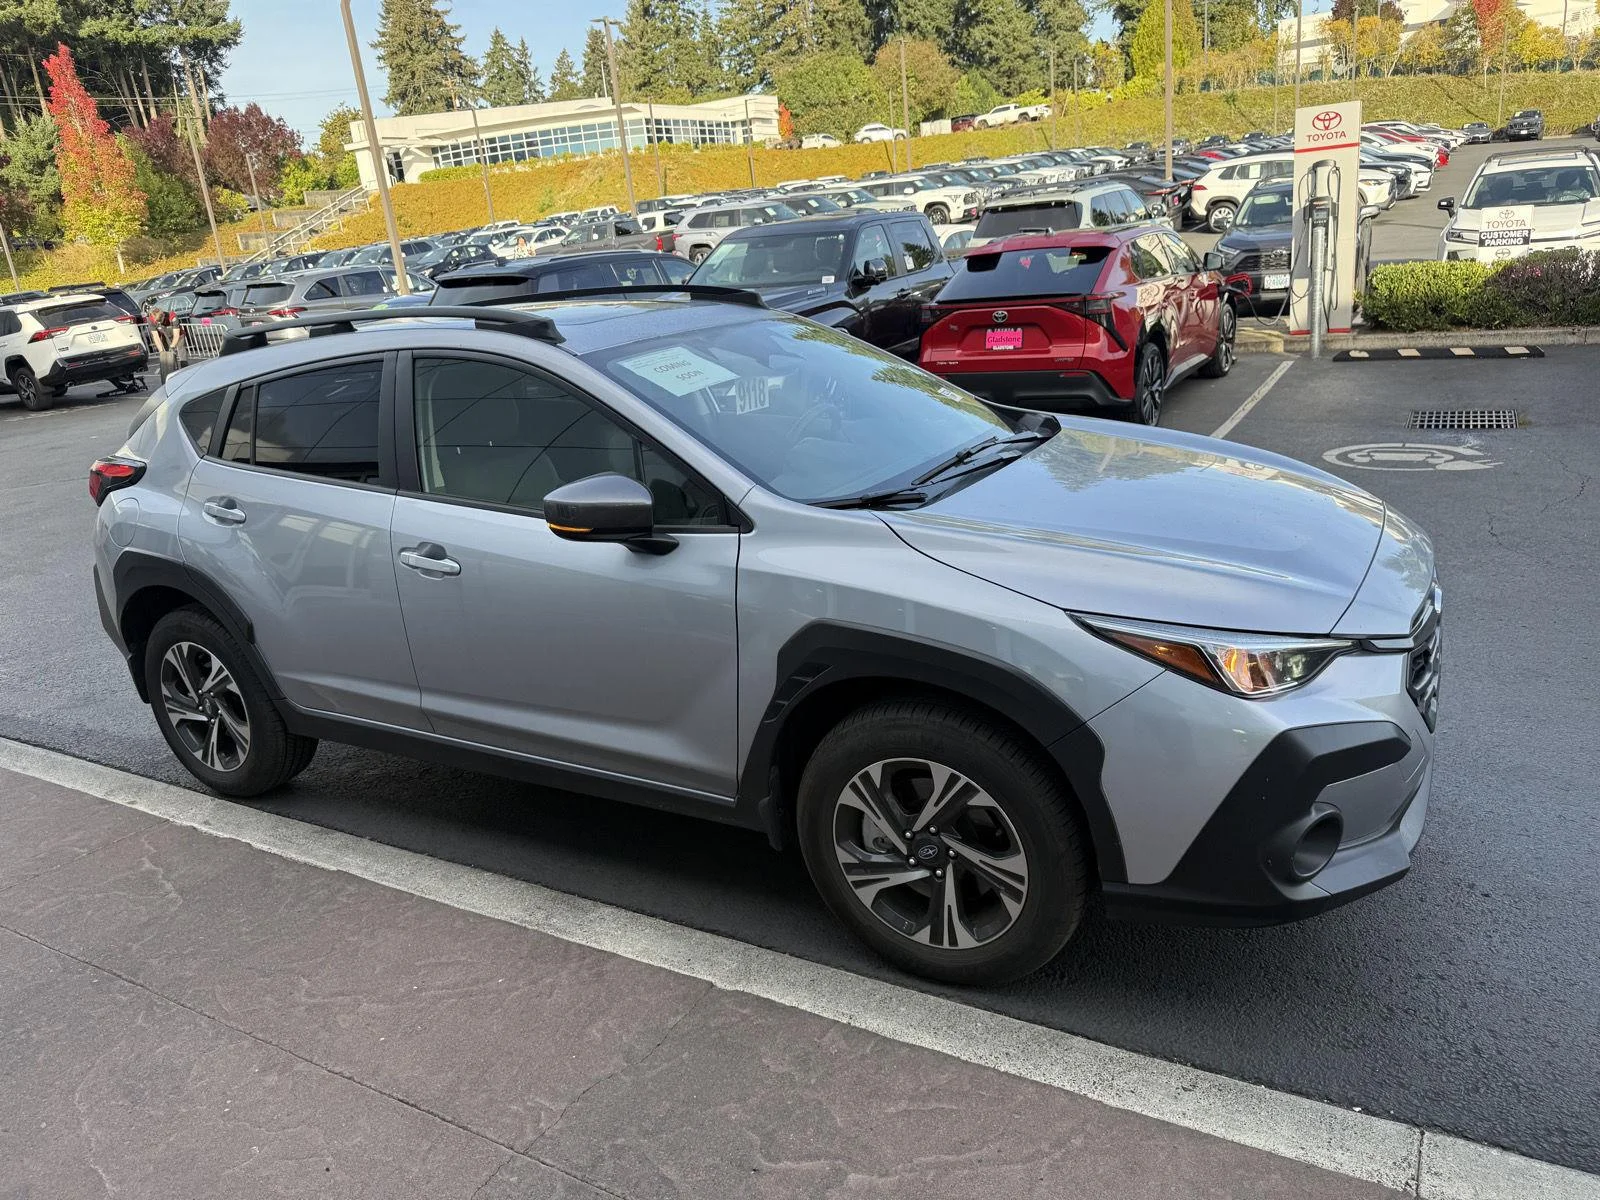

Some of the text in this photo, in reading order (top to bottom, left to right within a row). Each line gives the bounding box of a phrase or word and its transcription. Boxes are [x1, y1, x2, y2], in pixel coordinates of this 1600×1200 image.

[1306, 131, 1347, 142] TOYOTA
[1485, 219, 1527, 229] TOYOTA
[1480, 230, 1529, 240] CUSTOMER
[1484, 237, 1524, 246] PARKING
[987, 336, 1022, 344] Gladstone
[653, 360, 692, 373] COMING
[674, 369, 705, 381] SOON
